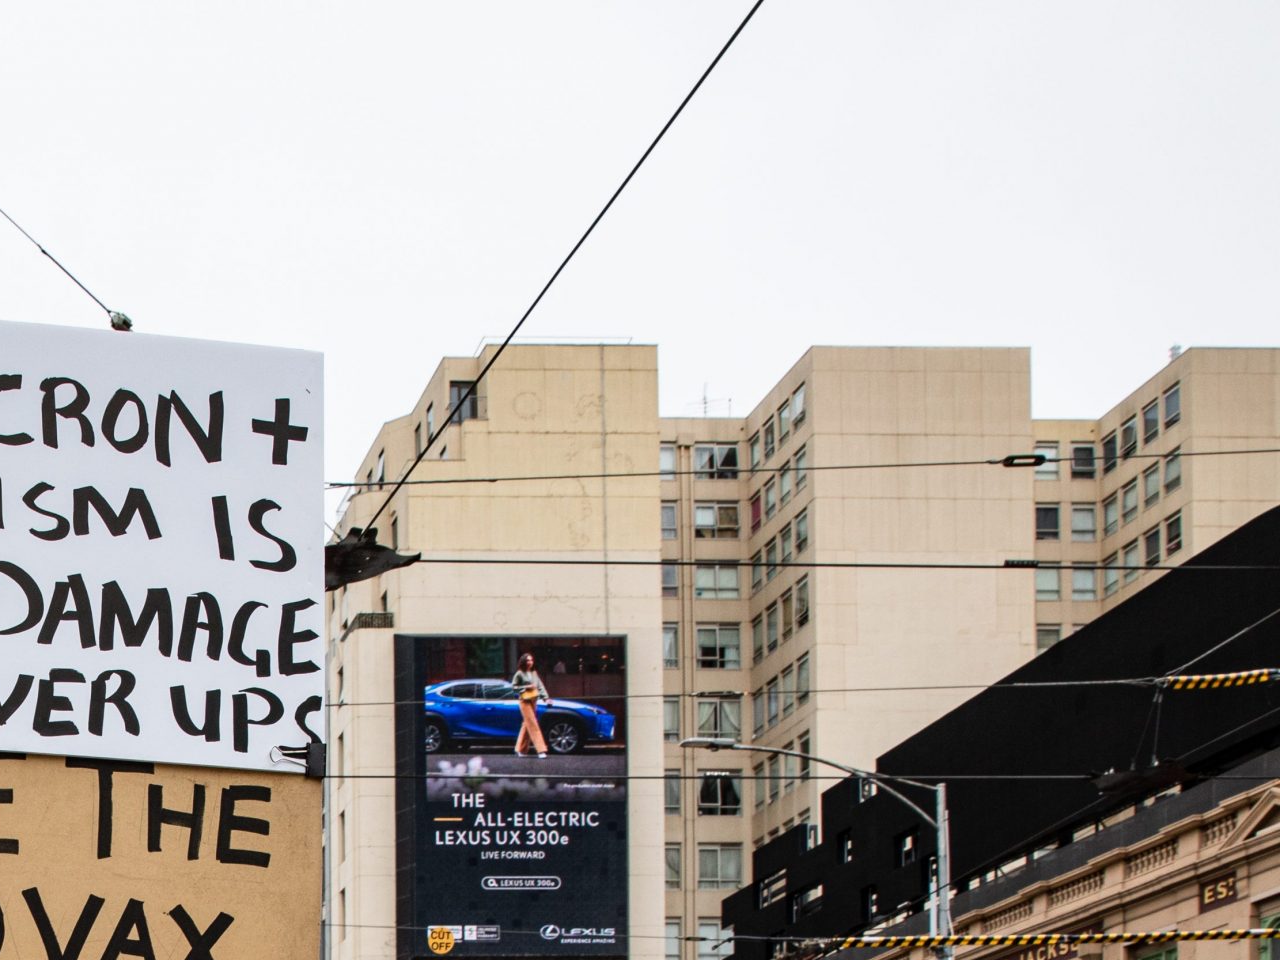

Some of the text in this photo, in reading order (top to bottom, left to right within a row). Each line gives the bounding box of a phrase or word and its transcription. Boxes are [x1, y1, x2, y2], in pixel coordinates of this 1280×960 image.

[211, 494, 297, 573] IS
[169, 684, 323, 754] UPS
[451, 793, 485, 808] THE
[65, 757, 272, 868] THE
[474, 811, 600, 827] ALL-ELECTRIC
[435, 830, 569, 845] LEXUS UX 300e
[481, 851, 545, 860] LIVE FORWARD
[500, 879, 523, 887] LEXUS
[430, 931, 451, 940] CUT
[561, 927, 616, 936] LEXUS
[431, 942, 451, 950] OFF
